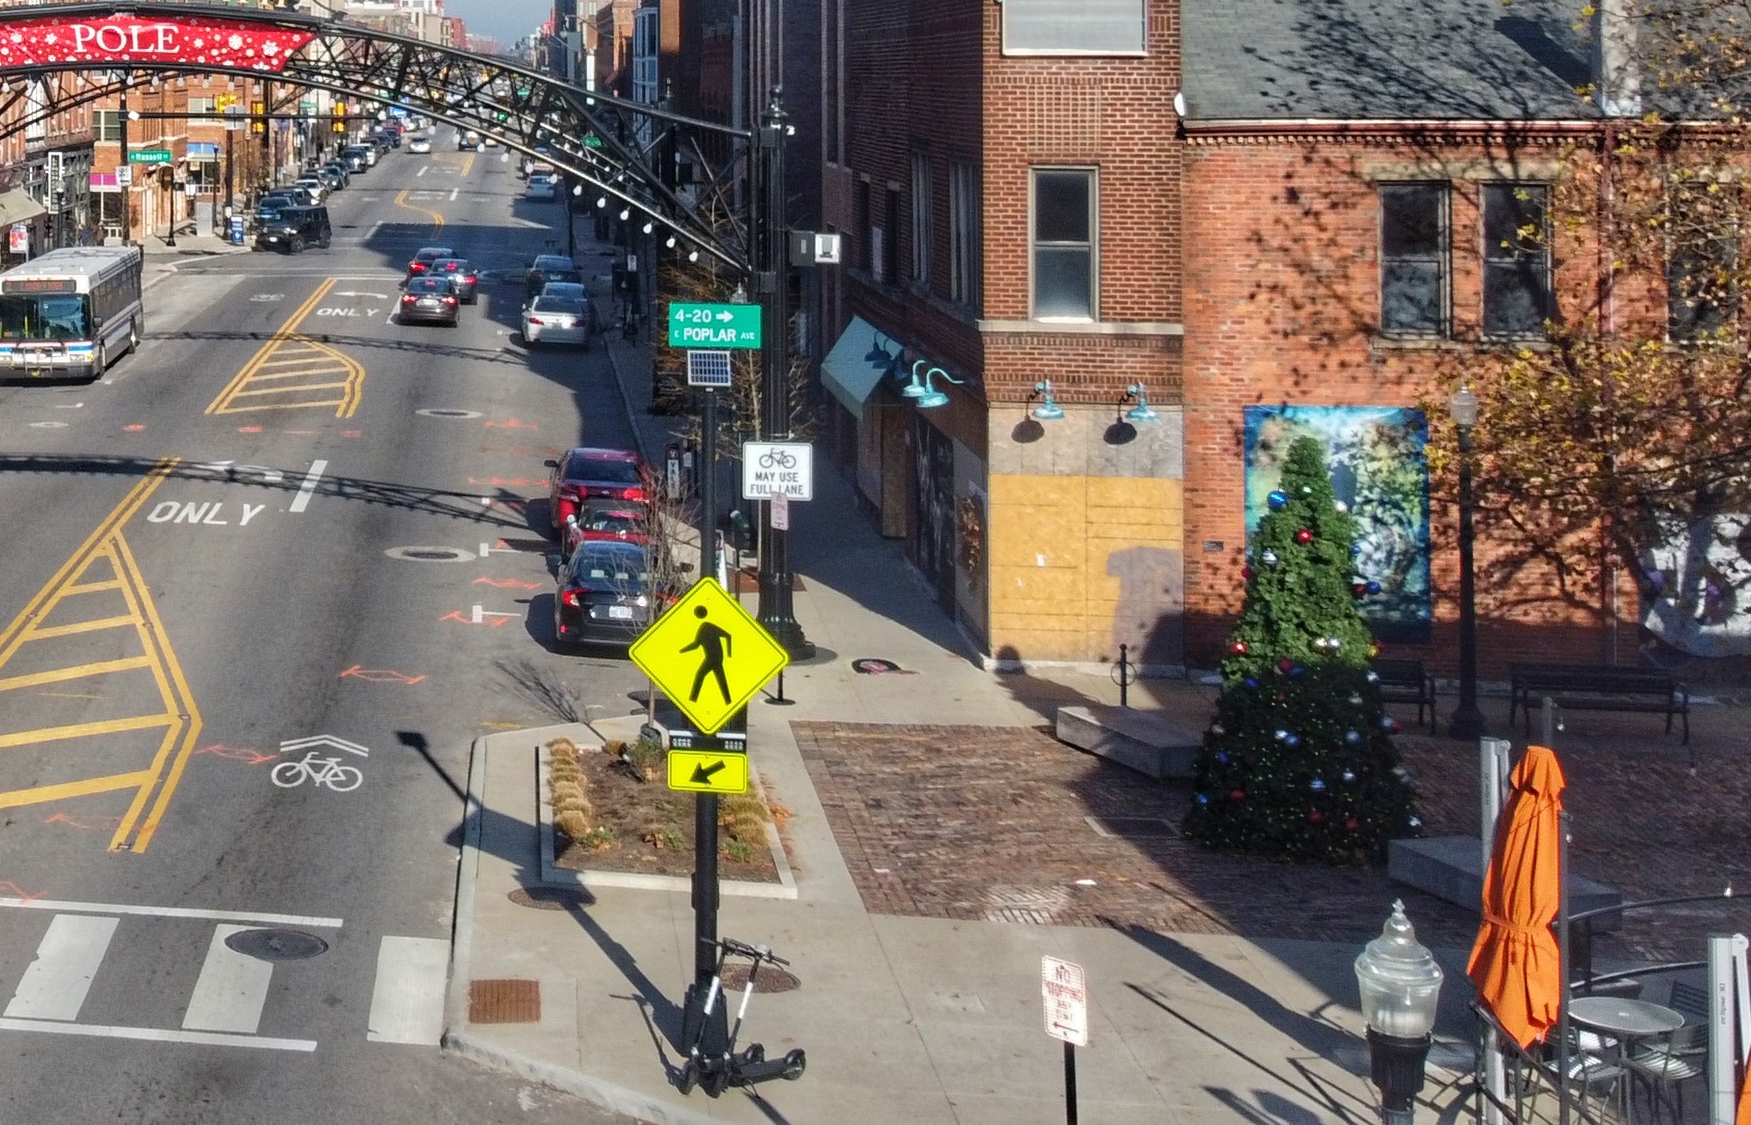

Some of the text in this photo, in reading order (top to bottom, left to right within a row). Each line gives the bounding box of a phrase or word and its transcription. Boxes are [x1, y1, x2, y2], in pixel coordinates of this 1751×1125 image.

[70, 24, 180, 54] POLE
[316, 307, 379, 317] ONLY
[674, 309, 712, 323] 4-20
[683, 327, 736, 342] POPLAR
[740, 331, 755, 340] AVE
[755, 472, 799, 483] MAY USE
[750, 484, 804, 495] FULL LANE
[147, 500, 266, 526] ONLY
[1055, 966, 1071, 984] NO
